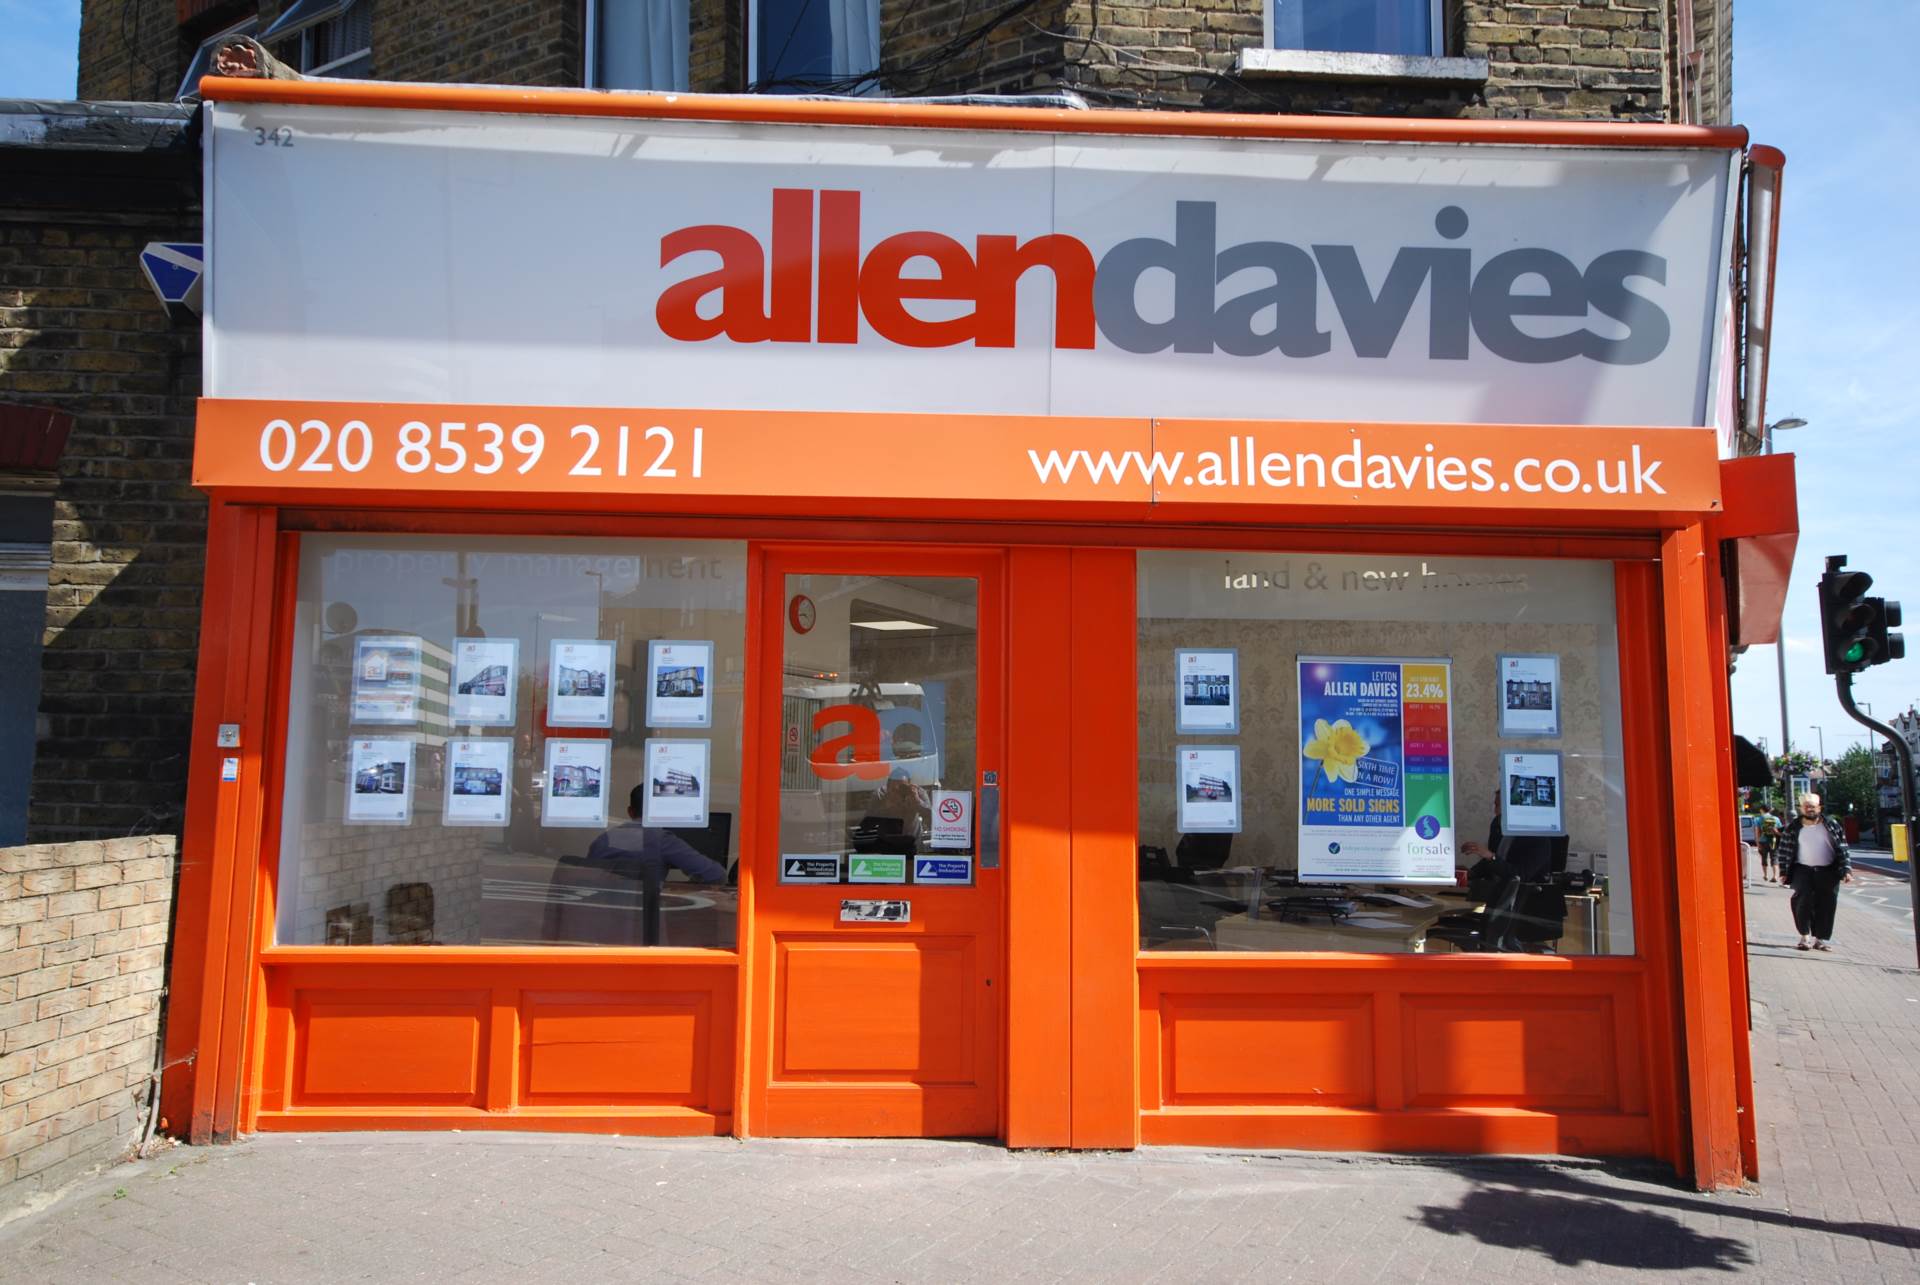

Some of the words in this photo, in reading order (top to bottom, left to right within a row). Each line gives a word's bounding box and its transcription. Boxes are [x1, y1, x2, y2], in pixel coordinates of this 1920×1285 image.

[254, 126, 294, 147] 342
[260, 419, 373, 473] 020
[395, 421, 545, 476] 8539
[568, 424, 703, 479] 2121
[1028, 436, 1666, 494] www.allendavies.co.uk
[1303, 562, 1328, 590] &
[1341, 569, 1410, 591] new
[1372, 671, 1397, 681] LEYTON
[1324, 681, 1356, 696] ALLEN
[1360, 682, 1398, 697] DAVIES
[1406, 683, 1444, 698] 23.4%
[1358, 760, 1377, 771] SIXTH
[1379, 764, 1396, 775] TIME
[1344, 788, 1355, 796] ONE
[1357, 788, 1375, 796] SIMPLE
[1375, 788, 1399, 797] MESSAGE
[1307, 797, 1336, 812] MORE
[1339, 798, 1365, 813] SOLD
[1368, 798, 1400, 814] SIGNS
[1338, 814, 1353, 823] THAN
[1353, 814, 1364, 823] ANY
[1365, 815, 1382, 823] OTHER
[1383, 815, 1400, 824] AGENT
